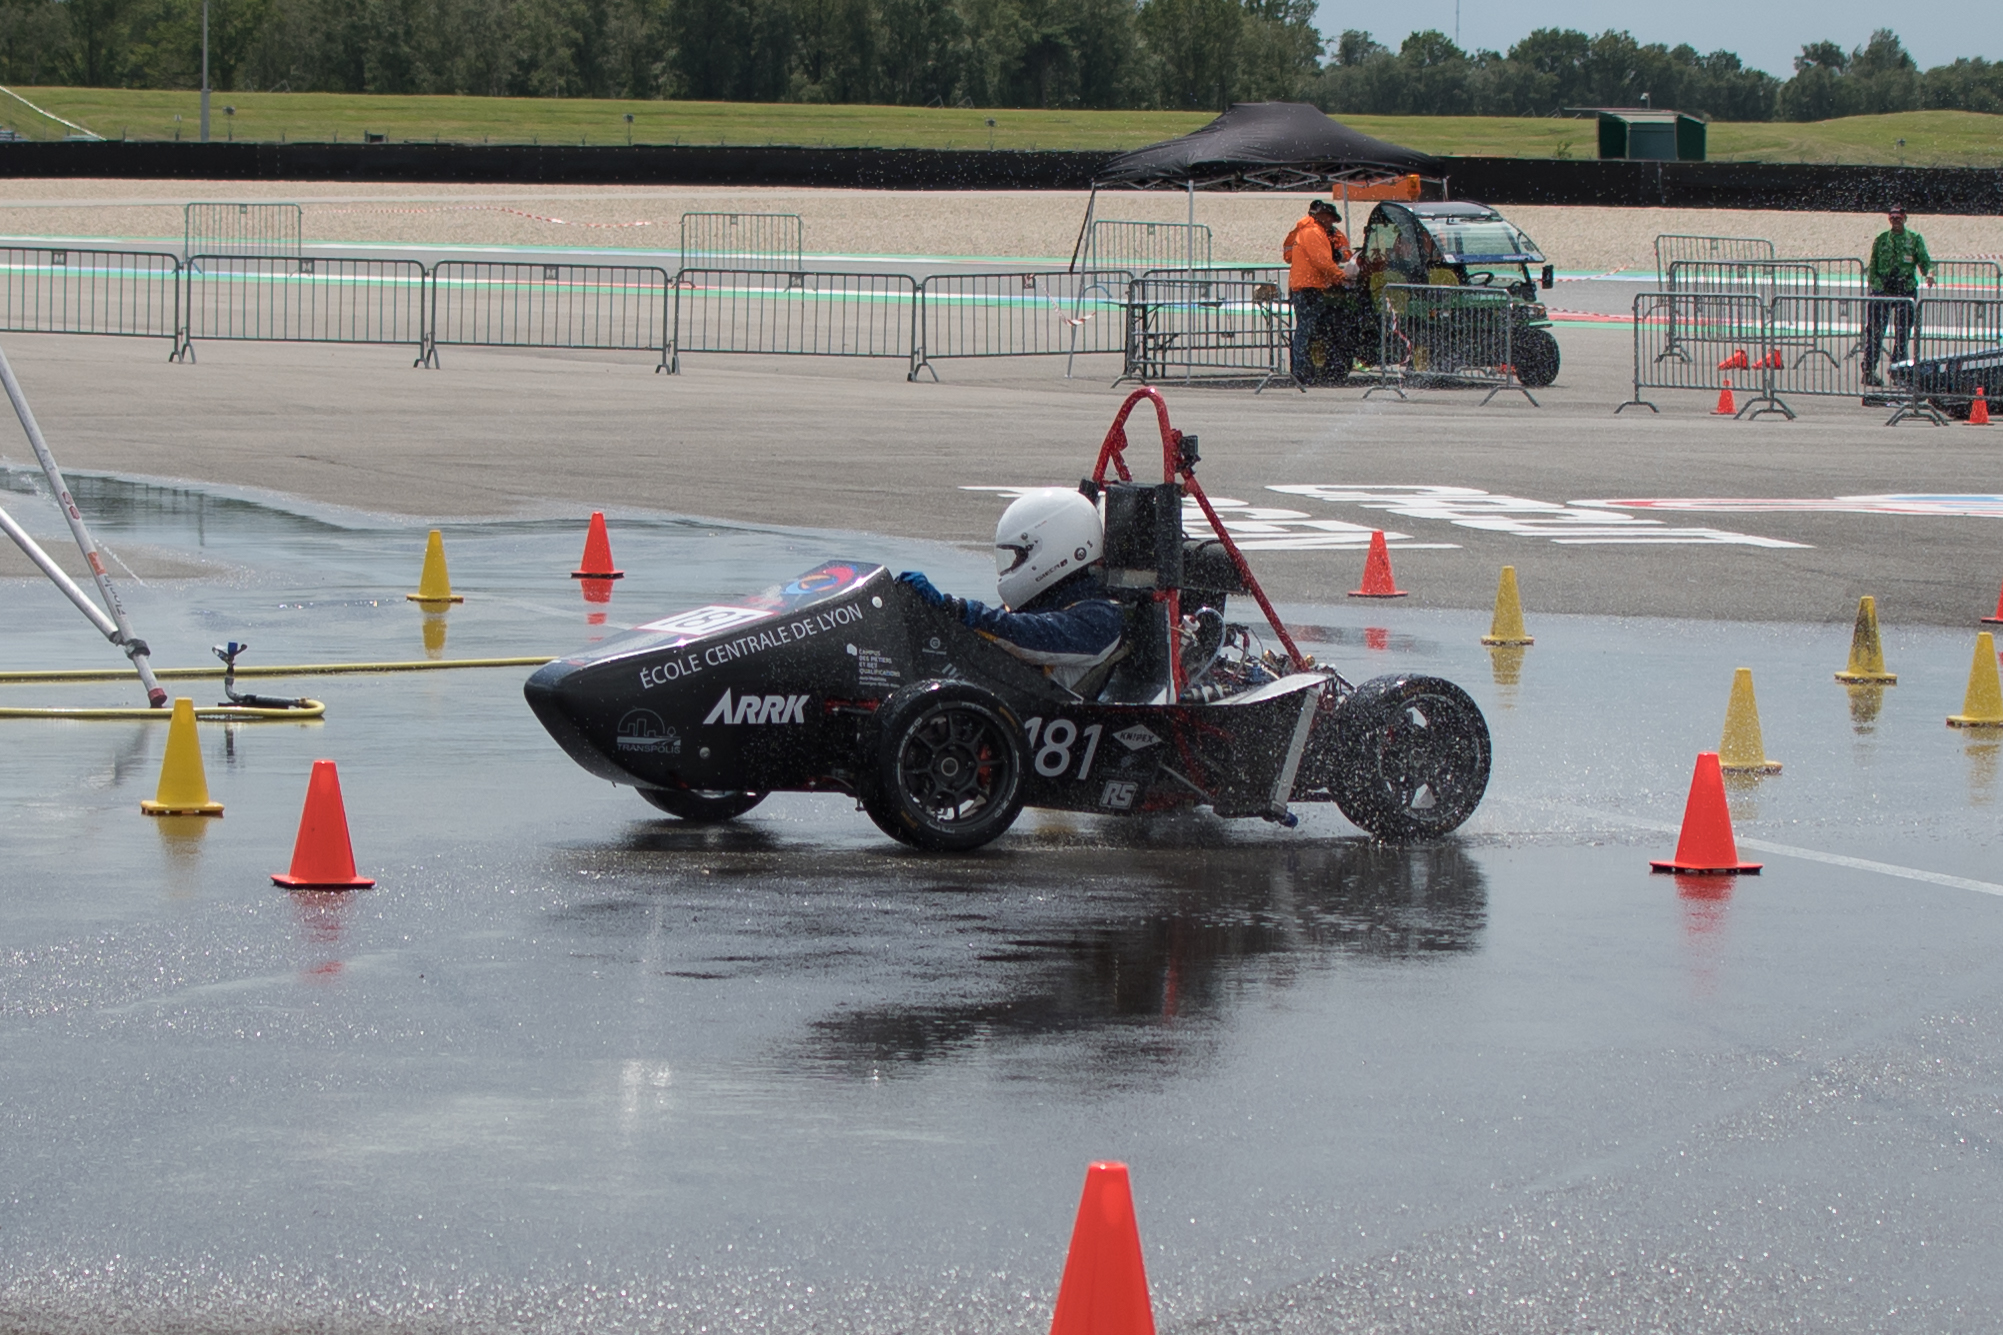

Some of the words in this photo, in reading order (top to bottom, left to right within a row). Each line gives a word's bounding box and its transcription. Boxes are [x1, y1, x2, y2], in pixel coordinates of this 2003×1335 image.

[1263, 484, 1817, 549] CIRCUIT
[639, 653, 701, 690] ÉCOLE
[705, 626, 791, 665] CENTRALE
[791, 619, 817, 641] DE
[818, 604, 863, 632] LYON
[703, 687, 810, 725] ARRK
[617, 743, 682, 755] TRANSPOLIS
[1024, 716, 1103, 781] 181
[1102, 782, 1135, 807] RS
